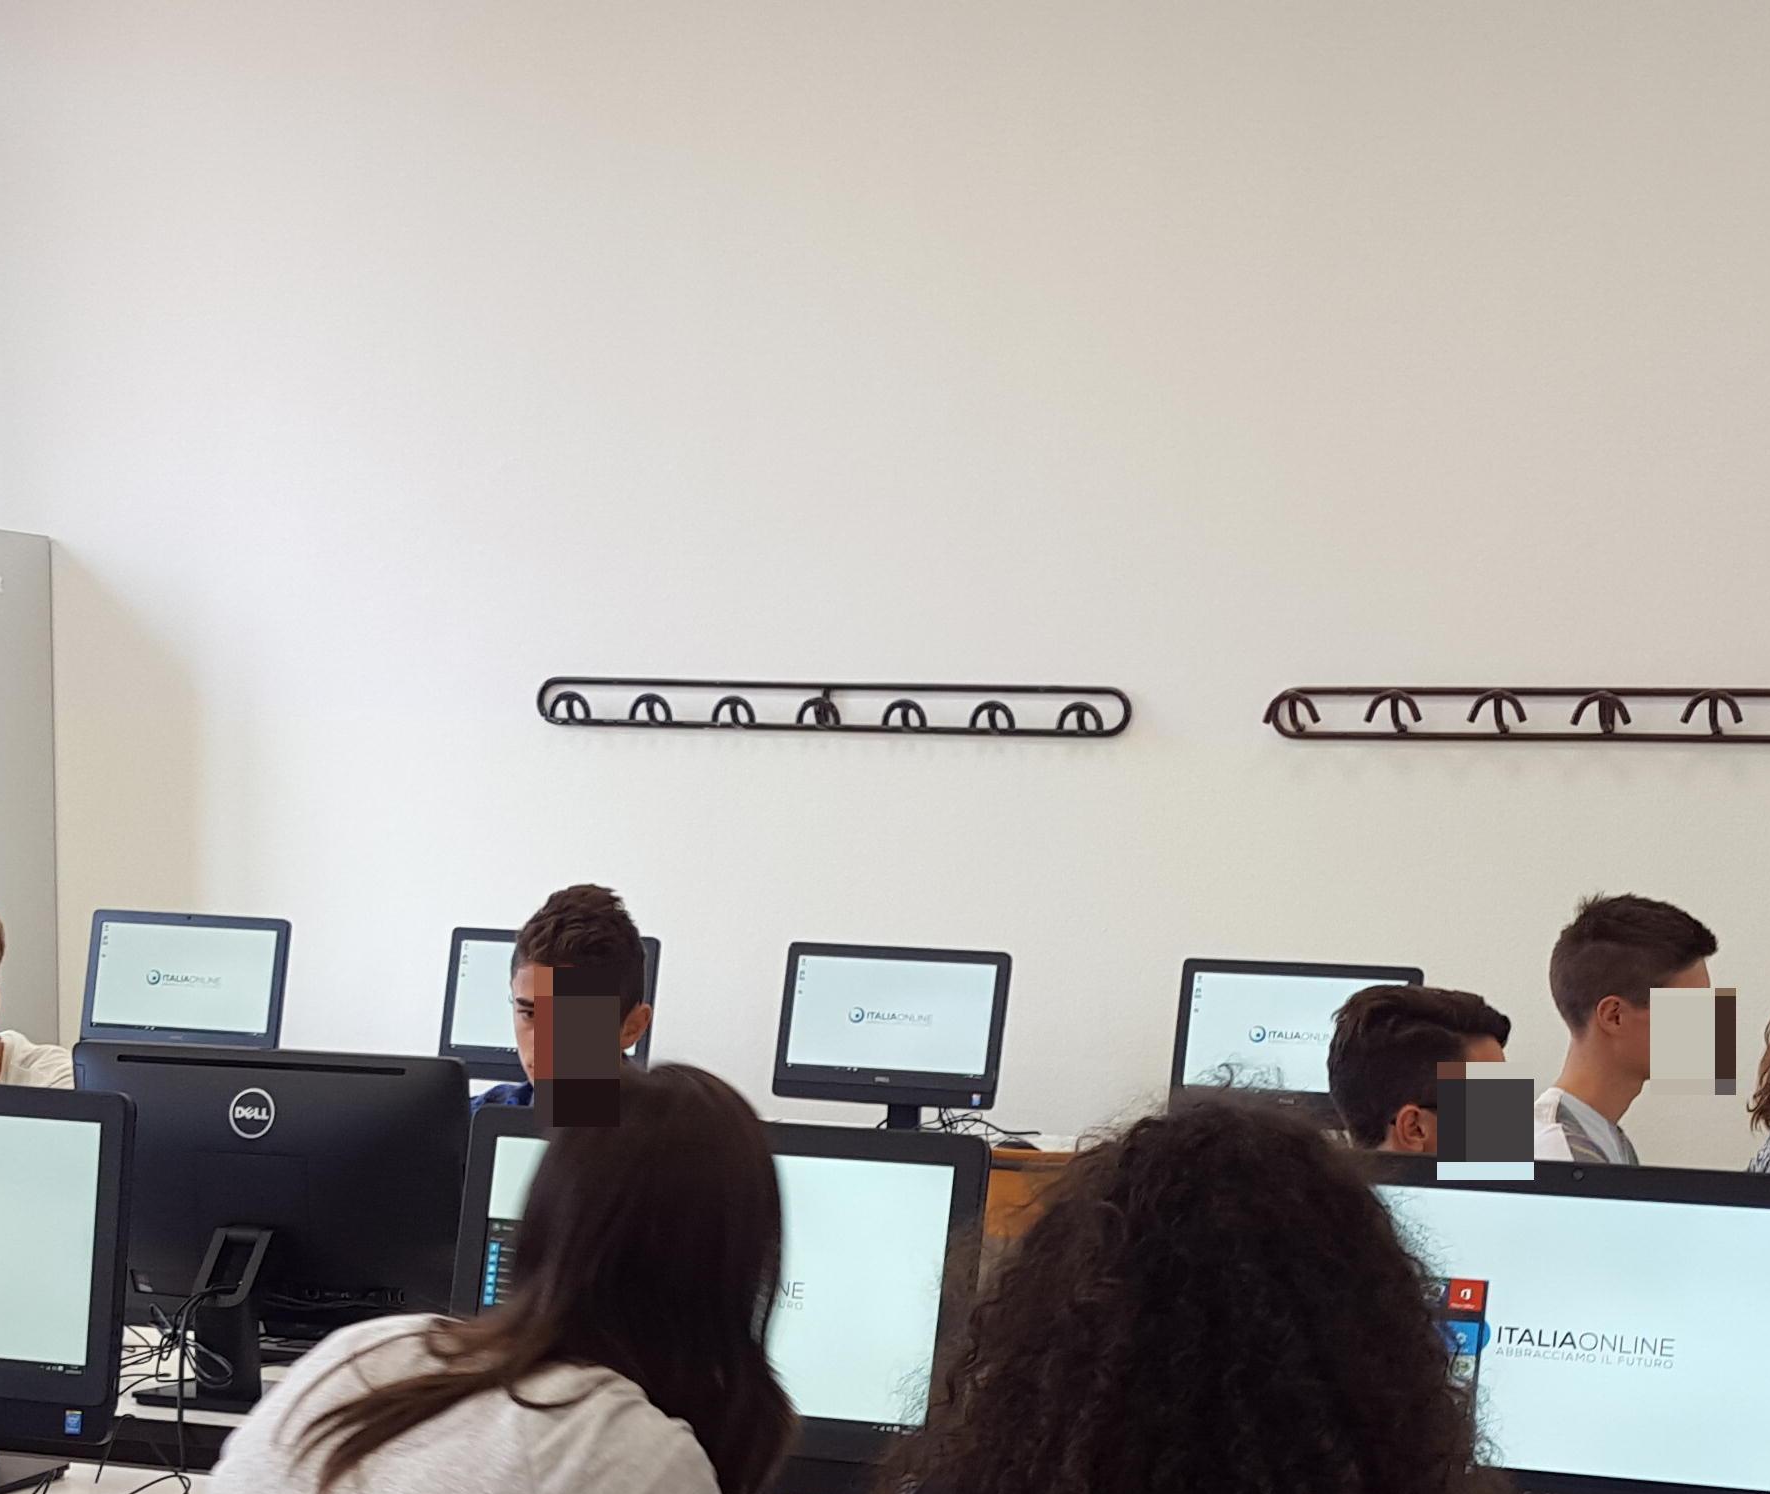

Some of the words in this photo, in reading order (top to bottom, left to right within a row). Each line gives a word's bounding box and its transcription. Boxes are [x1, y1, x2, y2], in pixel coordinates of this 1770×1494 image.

[866, 1011, 933, 1023] ITALIAONLINE
[234, 1106, 270, 1120] DELL
[1496, 1325, 1676, 1358] ITALIAONLINE
[1495, 1347, 1596, 1364] ABBRACCIAMO
[1601, 1354, 1613, 1365] IL
[1617, 1356, 1674, 1370] FUTURO
